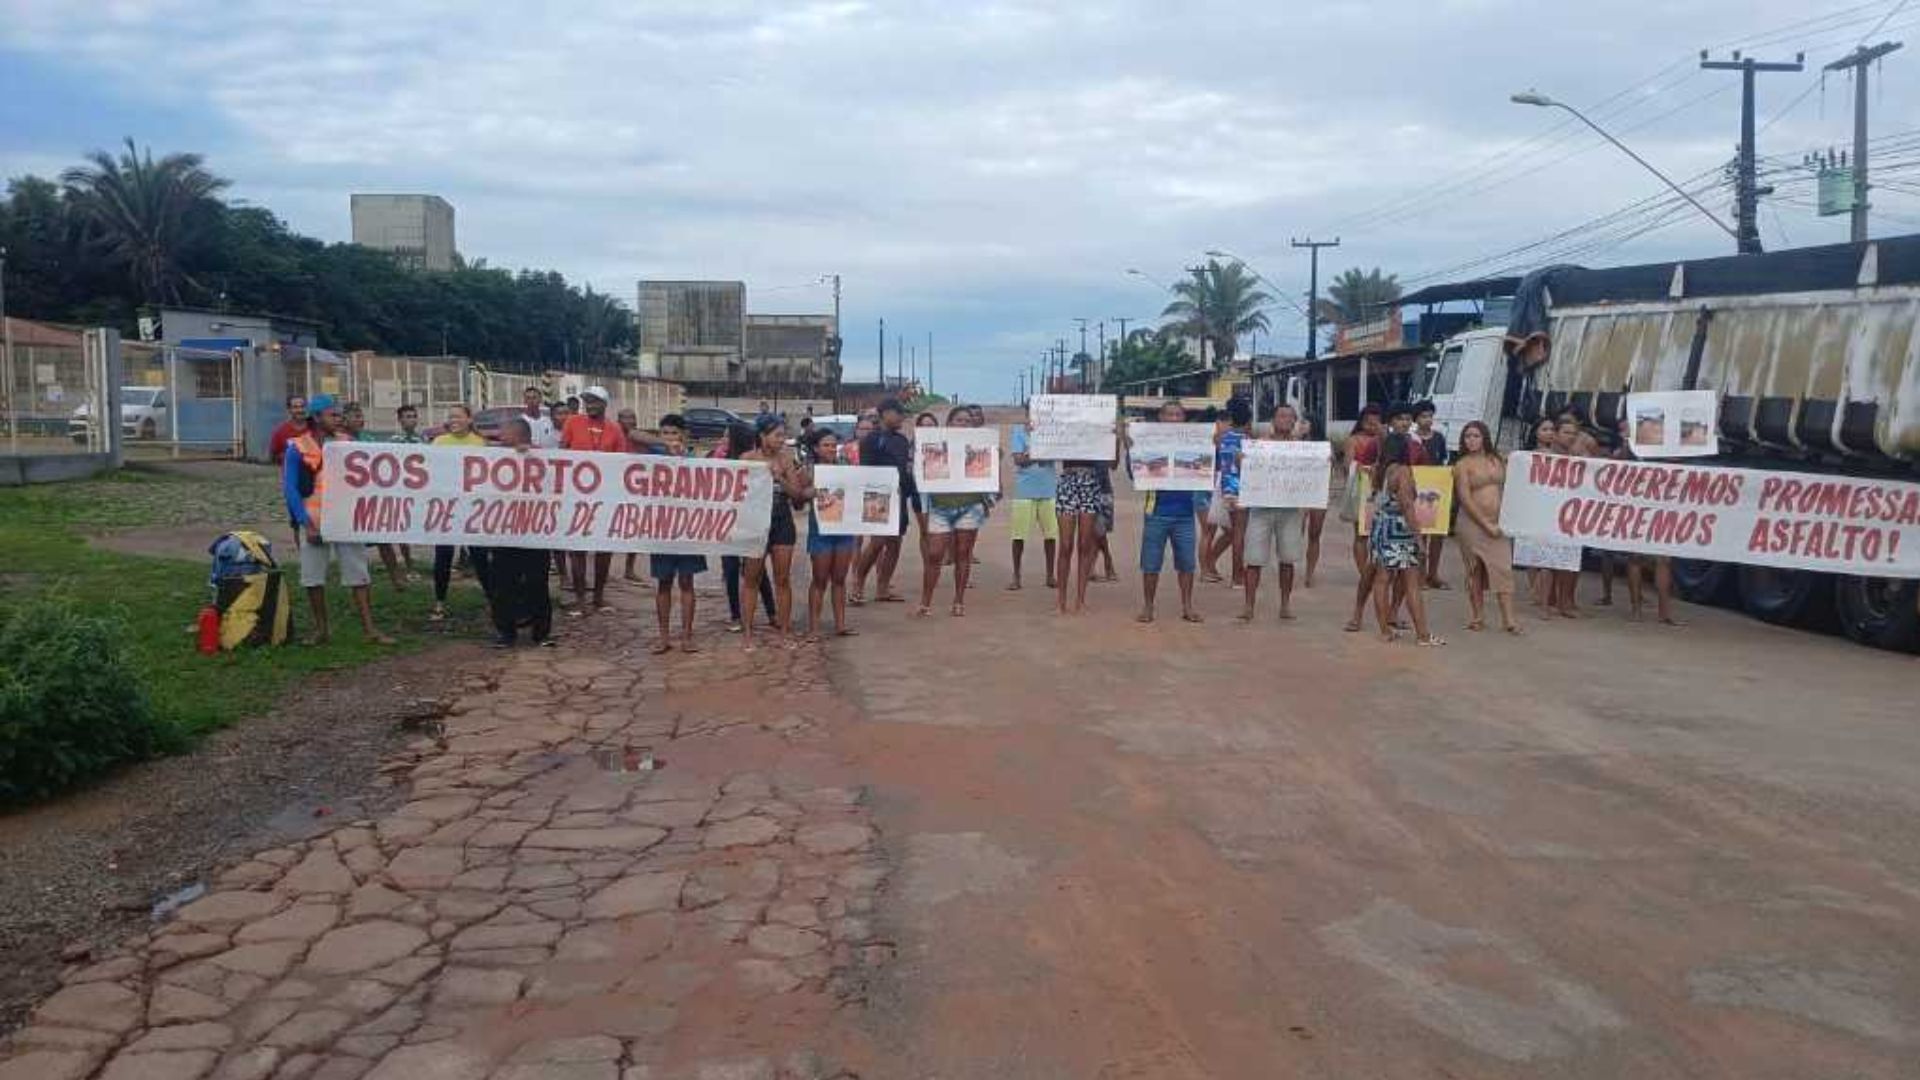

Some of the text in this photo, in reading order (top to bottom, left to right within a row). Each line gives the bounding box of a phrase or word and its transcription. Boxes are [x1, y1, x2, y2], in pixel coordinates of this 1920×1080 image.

[343, 450, 749, 502] SOS PORTO GRANDE
[1594, 463, 1744, 506] QUEREMOS
[1758, 478, 1920, 525] PROMESSA
[352, 496, 414, 532] MAIS
[423, 499, 463, 533] DE
[566, 501, 602, 537] DE
[608, 502, 737, 541] ABANDONO
[1557, 497, 1901, 563] QUEREMOS ASFALTO!
